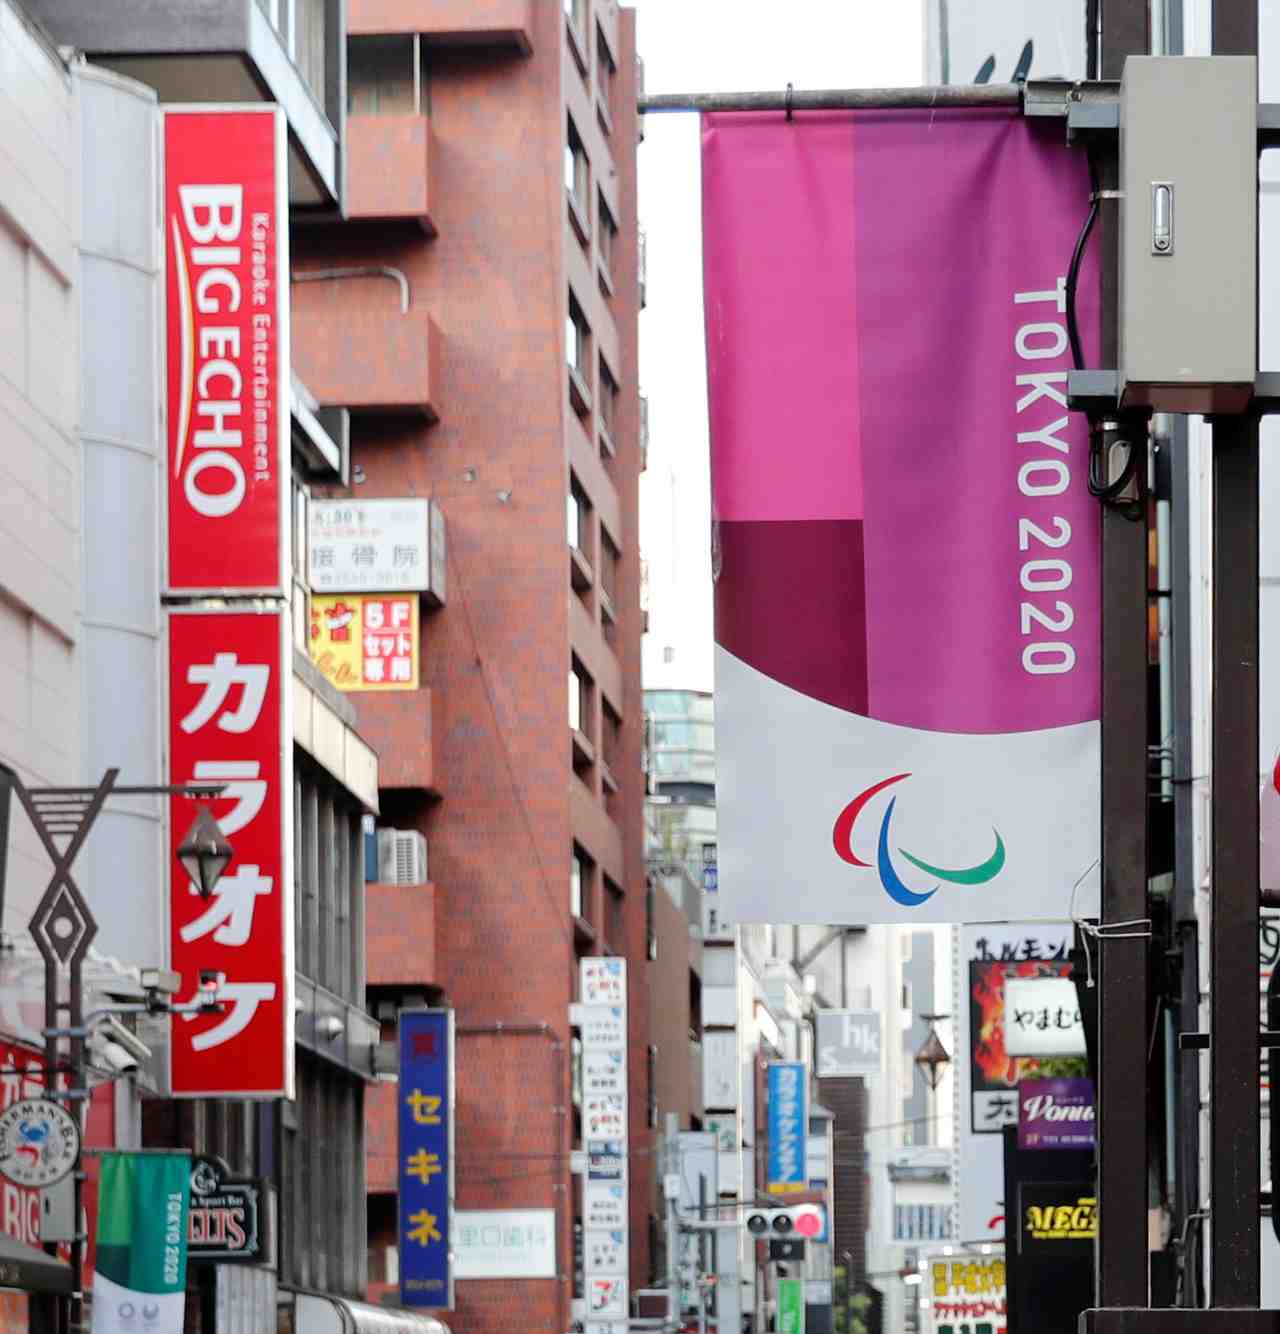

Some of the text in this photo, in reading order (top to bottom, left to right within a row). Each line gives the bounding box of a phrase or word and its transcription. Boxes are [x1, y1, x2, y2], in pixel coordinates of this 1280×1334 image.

[178, 184, 247, 518] BIG ECHO
[250, 212, 272, 482] Karaoke Entertainment
[1012, 275, 1077, 676] TOKYO 2020
[166, 1193, 184, 1241] TOKYO
[406, 1088, 442, 1247] セキネ
